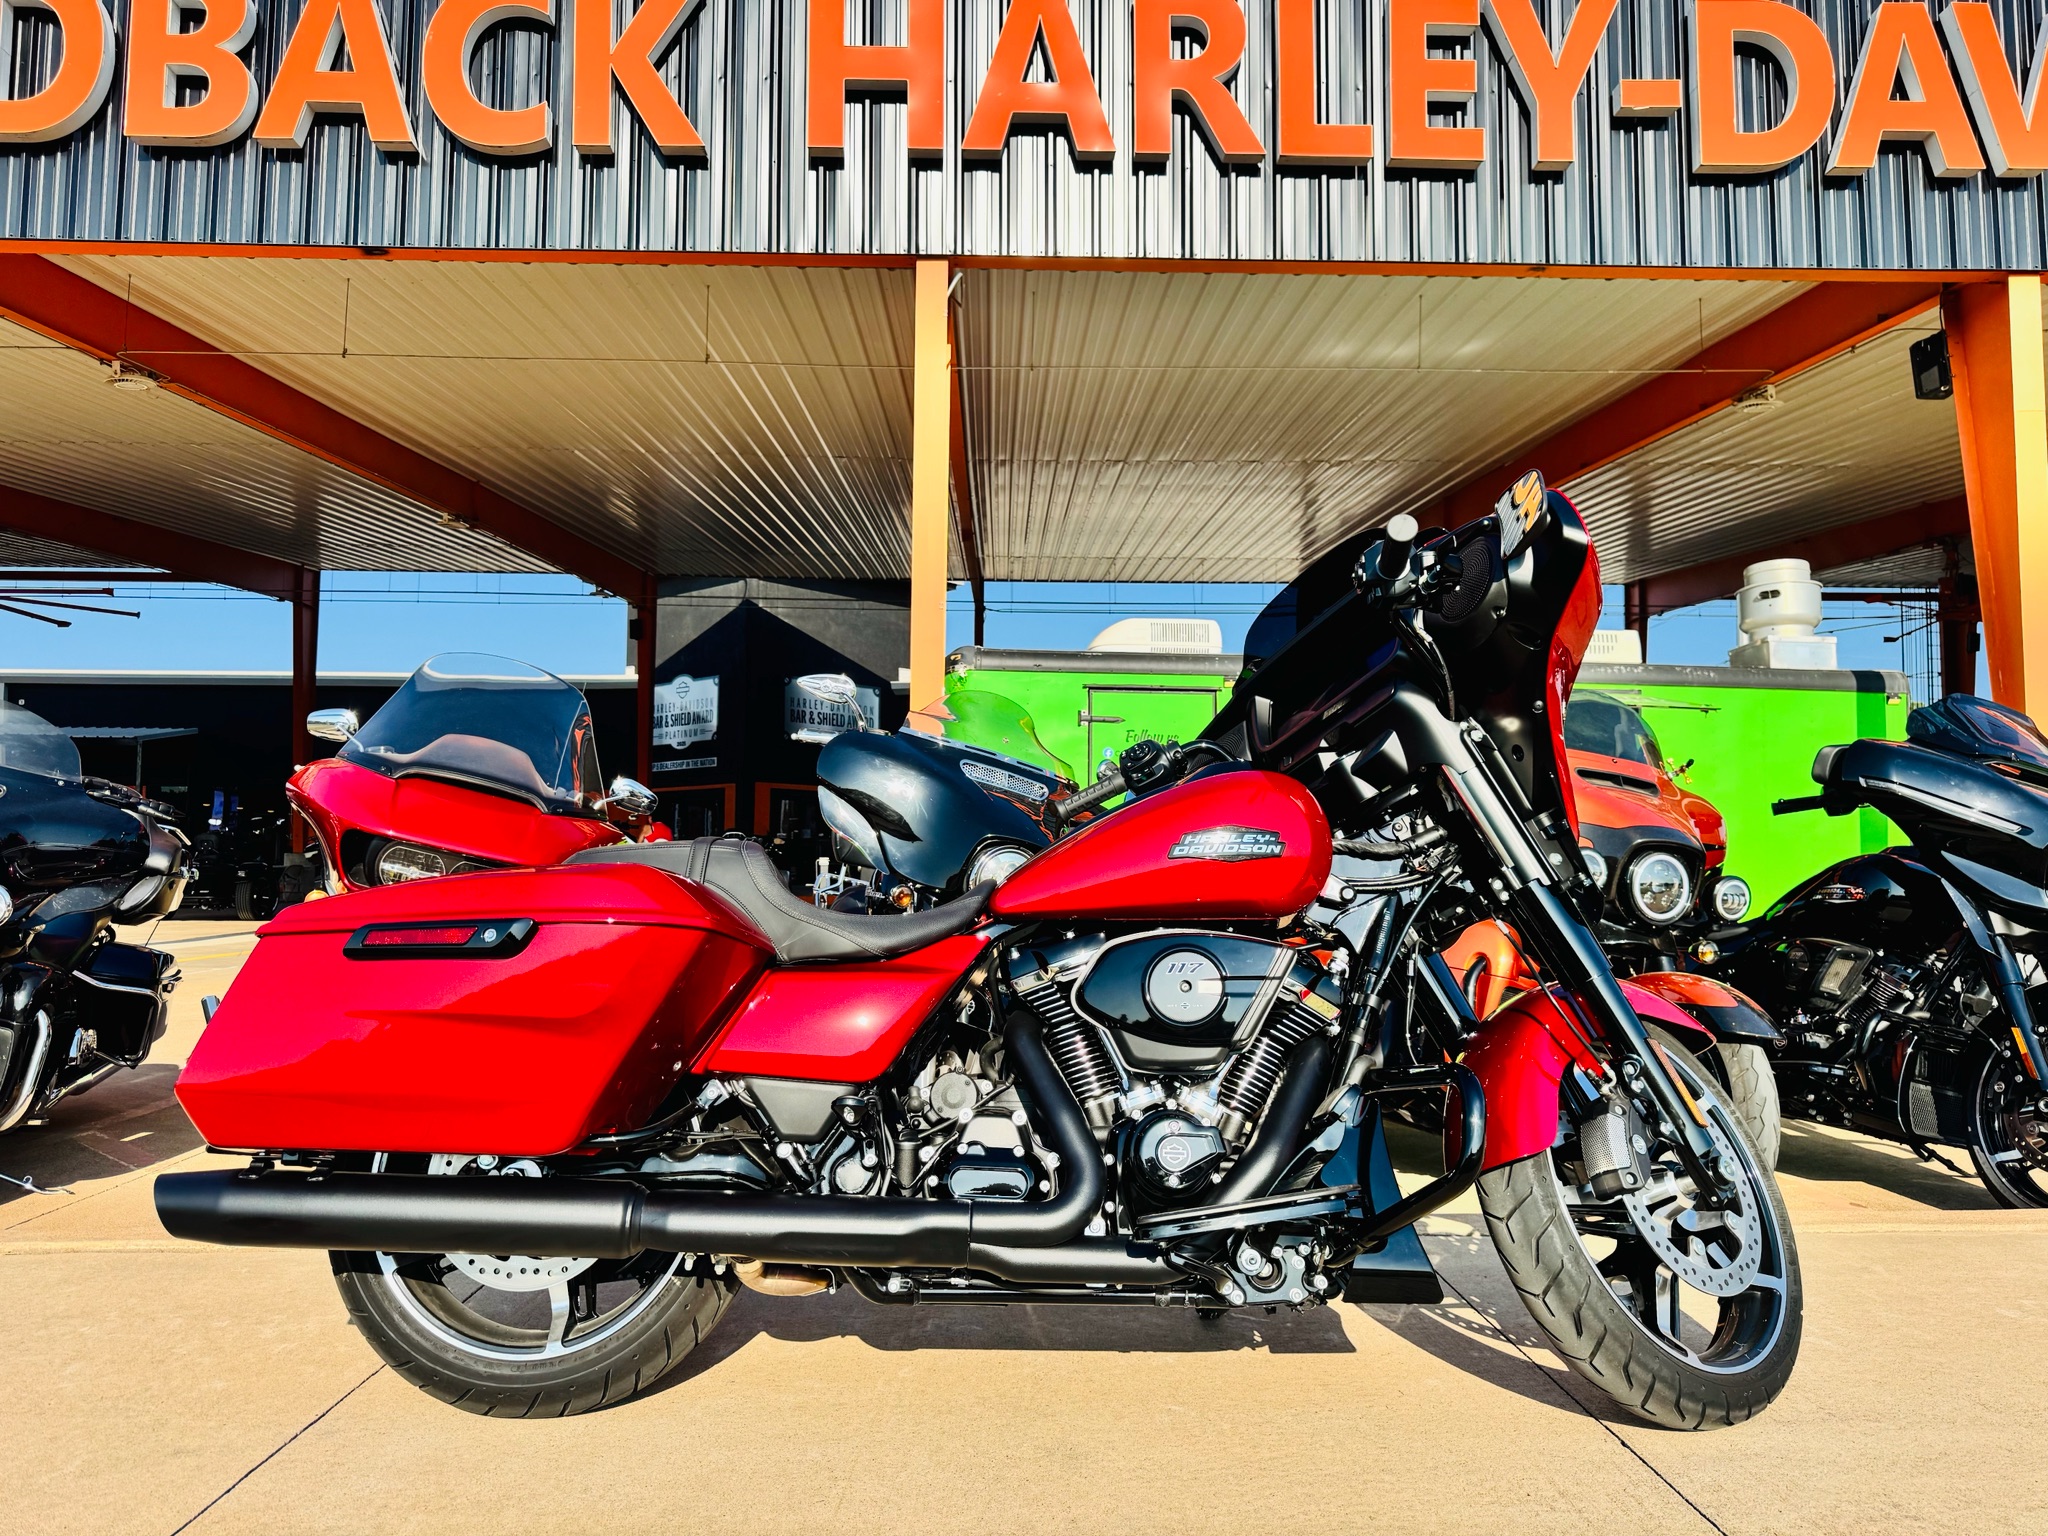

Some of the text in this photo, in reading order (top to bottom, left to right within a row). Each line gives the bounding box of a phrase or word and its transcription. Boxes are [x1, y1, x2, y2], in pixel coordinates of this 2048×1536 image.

[656, 697, 714, 714] ARLEY-DAVIDSON
[790, 697, 875, 716] HARLEY-DAVION
[670, 712, 691, 727] SHIELD
[692, 710, 714, 725] AWARD
[790, 709, 807, 725] BAR
[808, 711, 816, 725] &
[817, 712, 845, 727] SHIELD
[665, 728, 699, 740] PLATINUM
[691, 759, 699, 767] THE
[1184, 834, 1275, 845] HARLEY-
[1173, 844, 1282, 856] DAVIDSON
[1166, 962, 1205, 975] 117
